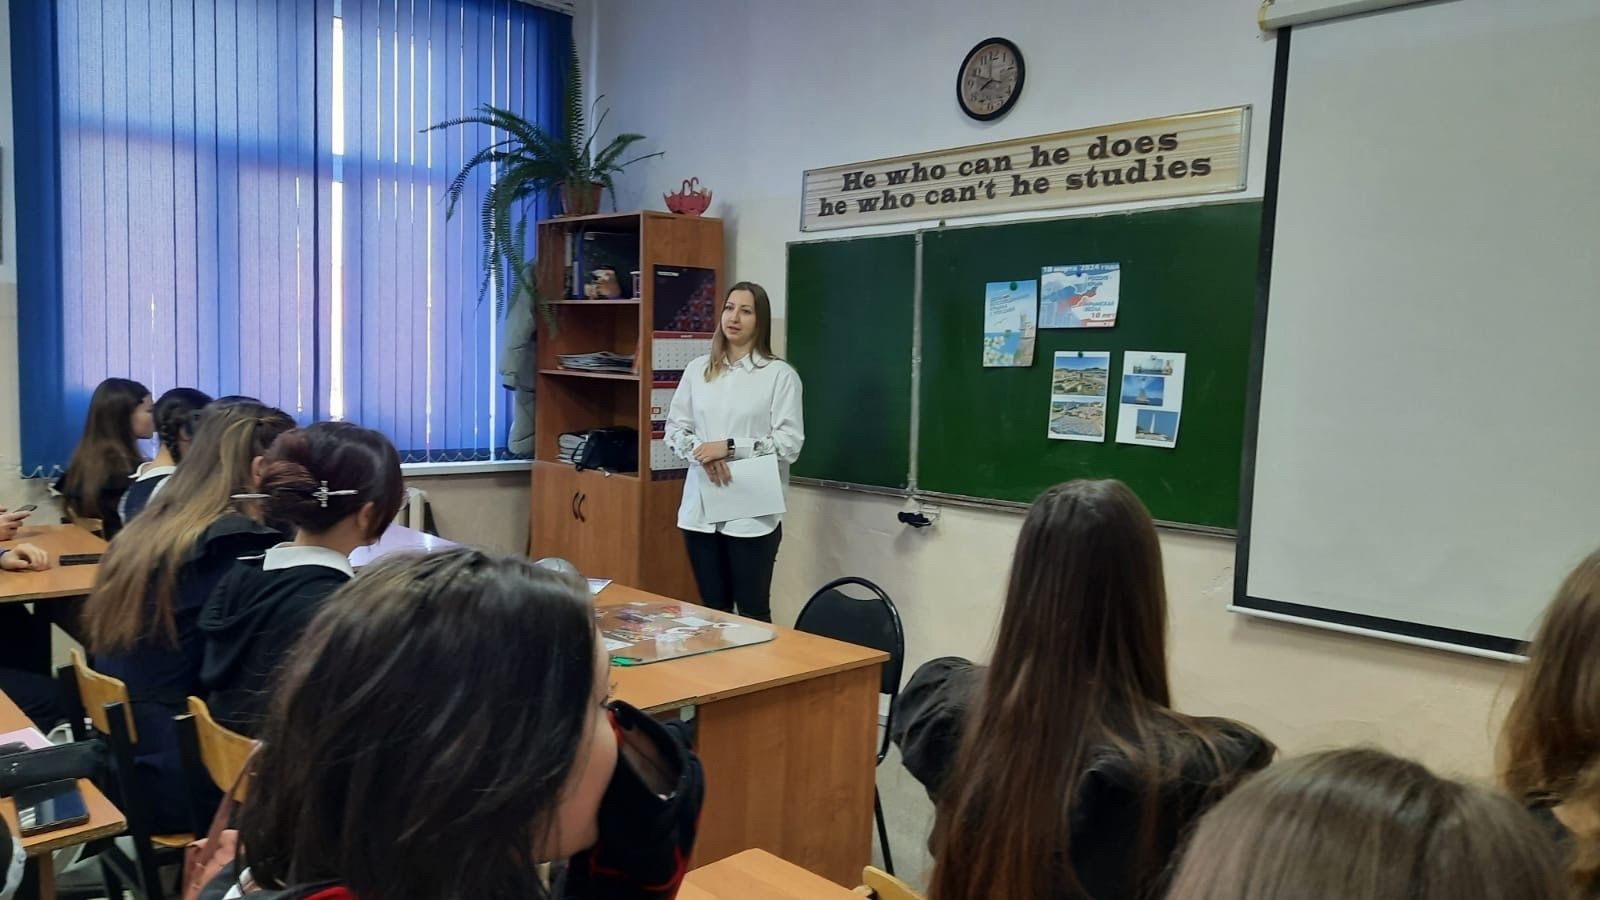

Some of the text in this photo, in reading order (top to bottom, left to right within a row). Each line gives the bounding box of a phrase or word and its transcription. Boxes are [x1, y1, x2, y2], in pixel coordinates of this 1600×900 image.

[817, 155, 1211, 217] he who can't he studies
[841, 132, 1178, 192] He who can he does
